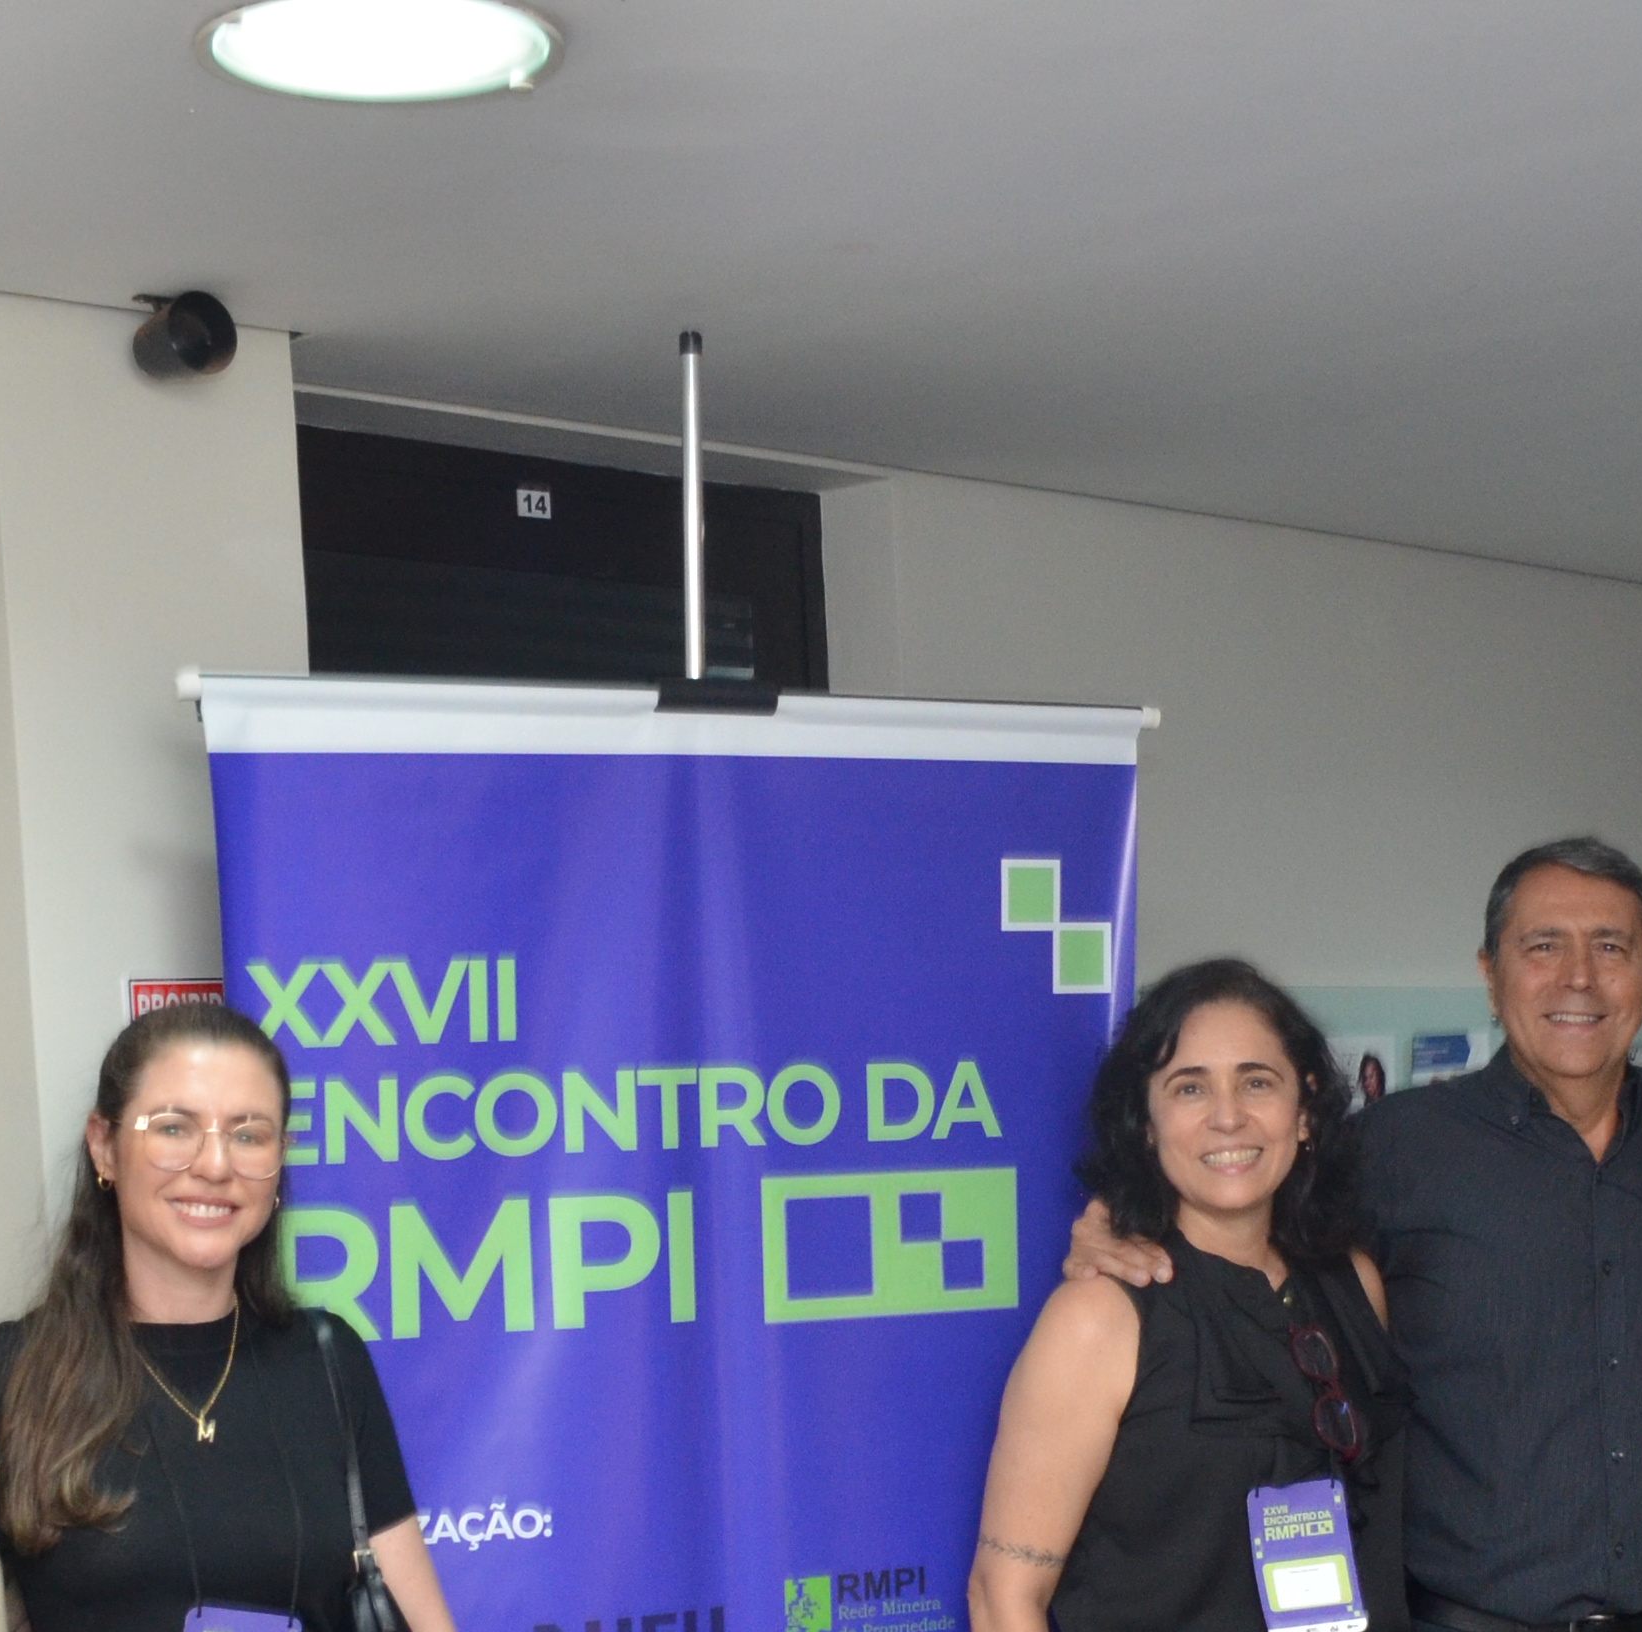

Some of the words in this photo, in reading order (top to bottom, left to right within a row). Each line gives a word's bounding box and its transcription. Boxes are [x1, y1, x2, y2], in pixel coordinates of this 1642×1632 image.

[523, 493, 547, 515] 14
[245, 957, 517, 1048] XXVII
[285, 1064, 841, 1167] ENCONTRO
[866, 1060, 1002, 1141] DA
[281, 1190, 697, 1343] RMPI
[1263, 1504, 1288, 1516] XXVII
[1263, 1511, 1317, 1526] ENCONTRO
[1318, 1509, 1332, 1520] DA
[1264, 1523, 1305, 1541] RMPI
[837, 1566, 925, 1603] RMPI
[838, 1603, 876, 1620] Rede
[882, 1598, 942, 1616] Mineira
